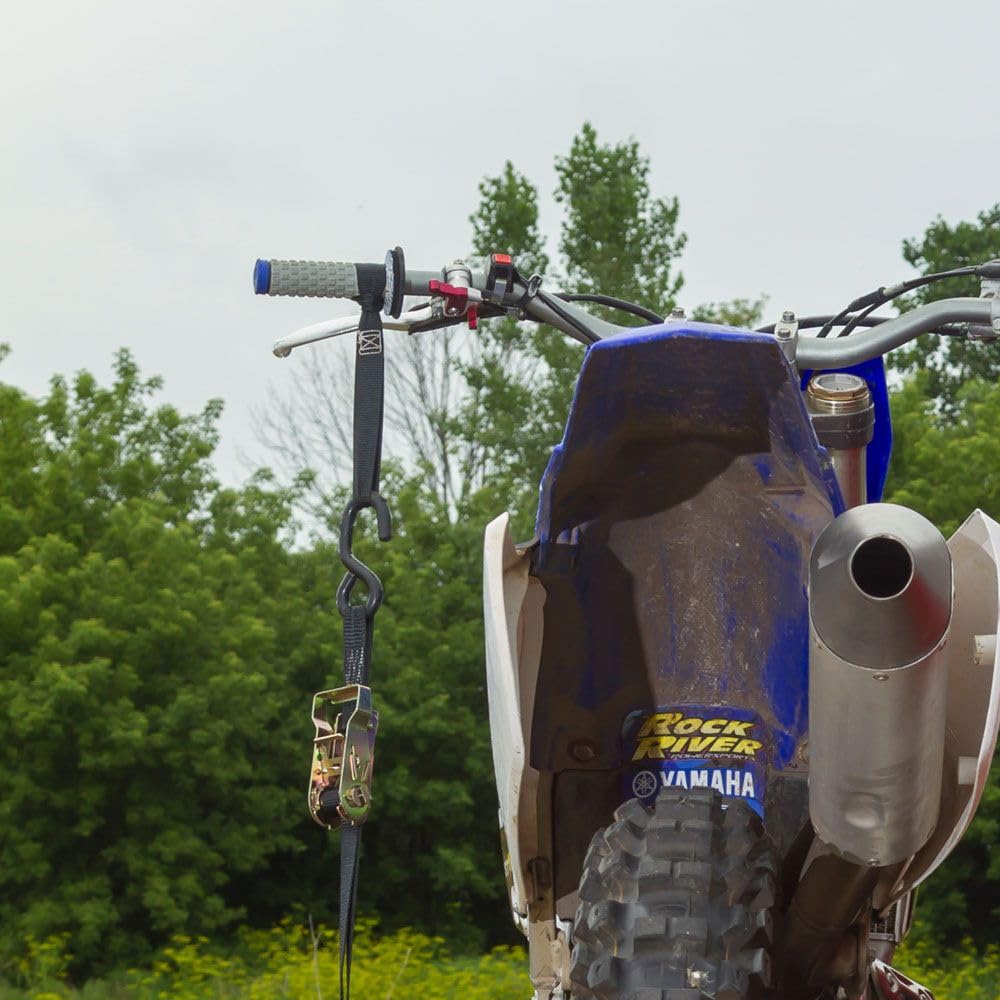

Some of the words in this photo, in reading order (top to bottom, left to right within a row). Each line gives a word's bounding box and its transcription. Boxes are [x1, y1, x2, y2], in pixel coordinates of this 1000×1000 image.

[637, 712, 756, 737] ROCK
[631, 736, 763, 761] RIVER
[660, 770, 755, 798] YAMAHA
